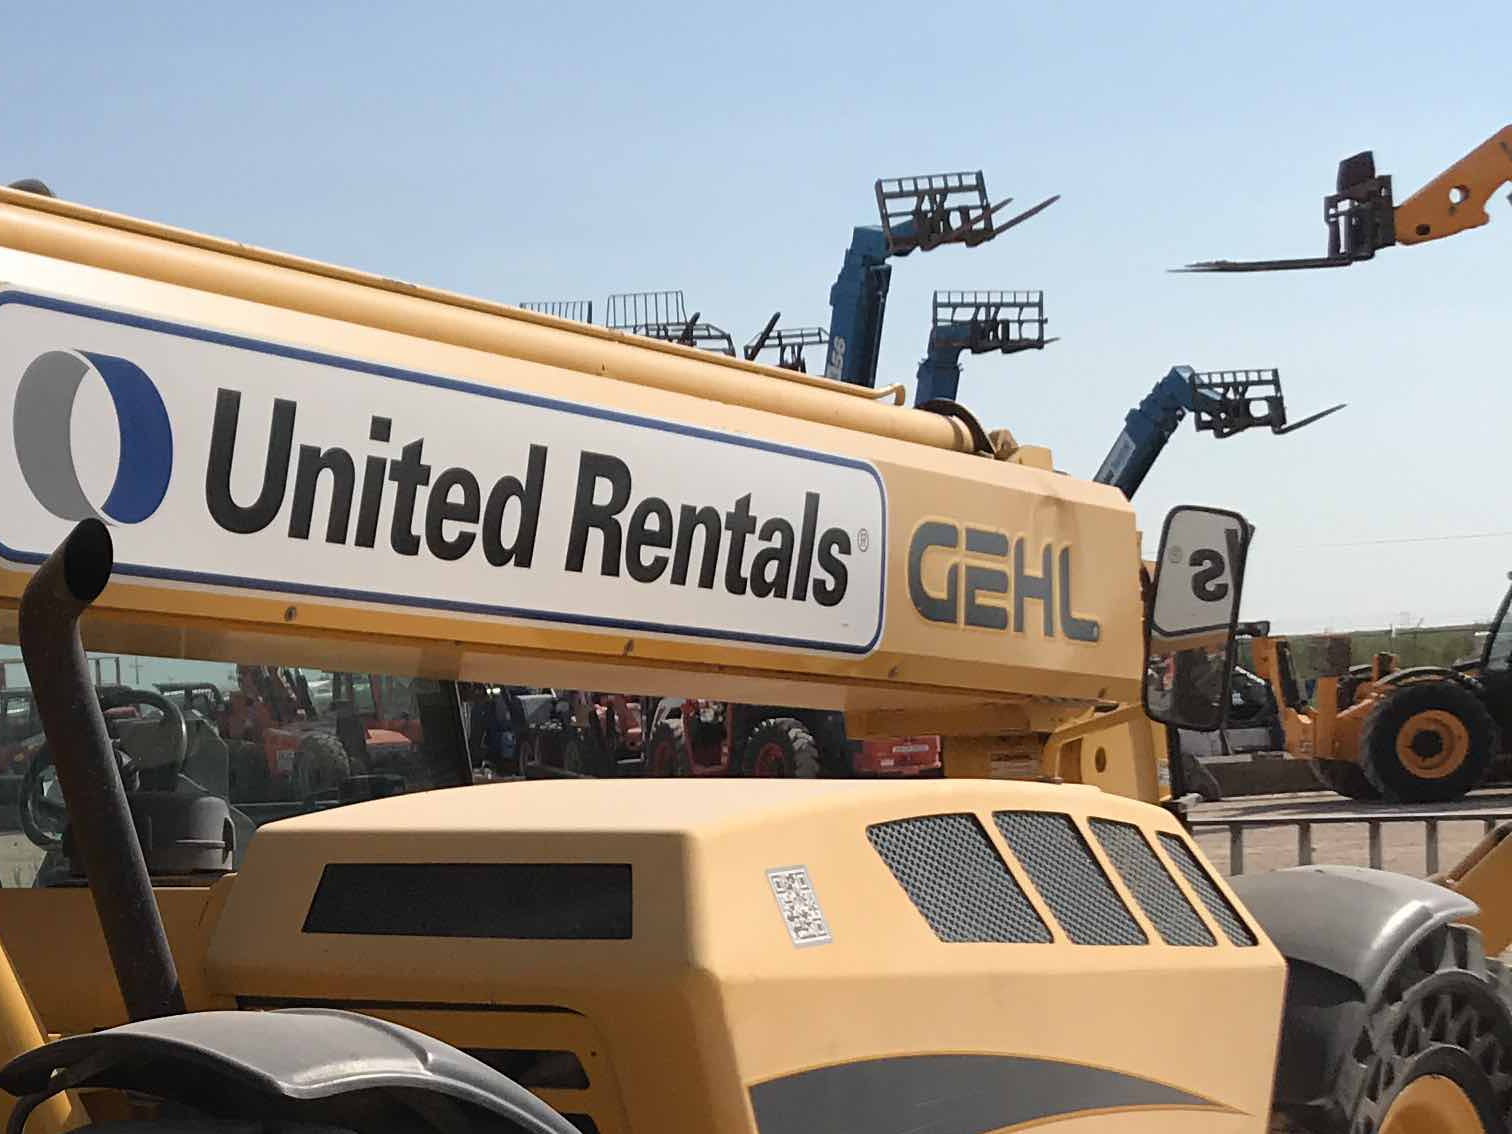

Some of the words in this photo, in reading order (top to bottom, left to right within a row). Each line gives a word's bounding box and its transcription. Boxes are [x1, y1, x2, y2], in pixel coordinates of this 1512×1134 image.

[204, 387, 548, 570] United
[564, 450, 852, 608] Rentals
[908, 520, 1100, 642] GEHL
